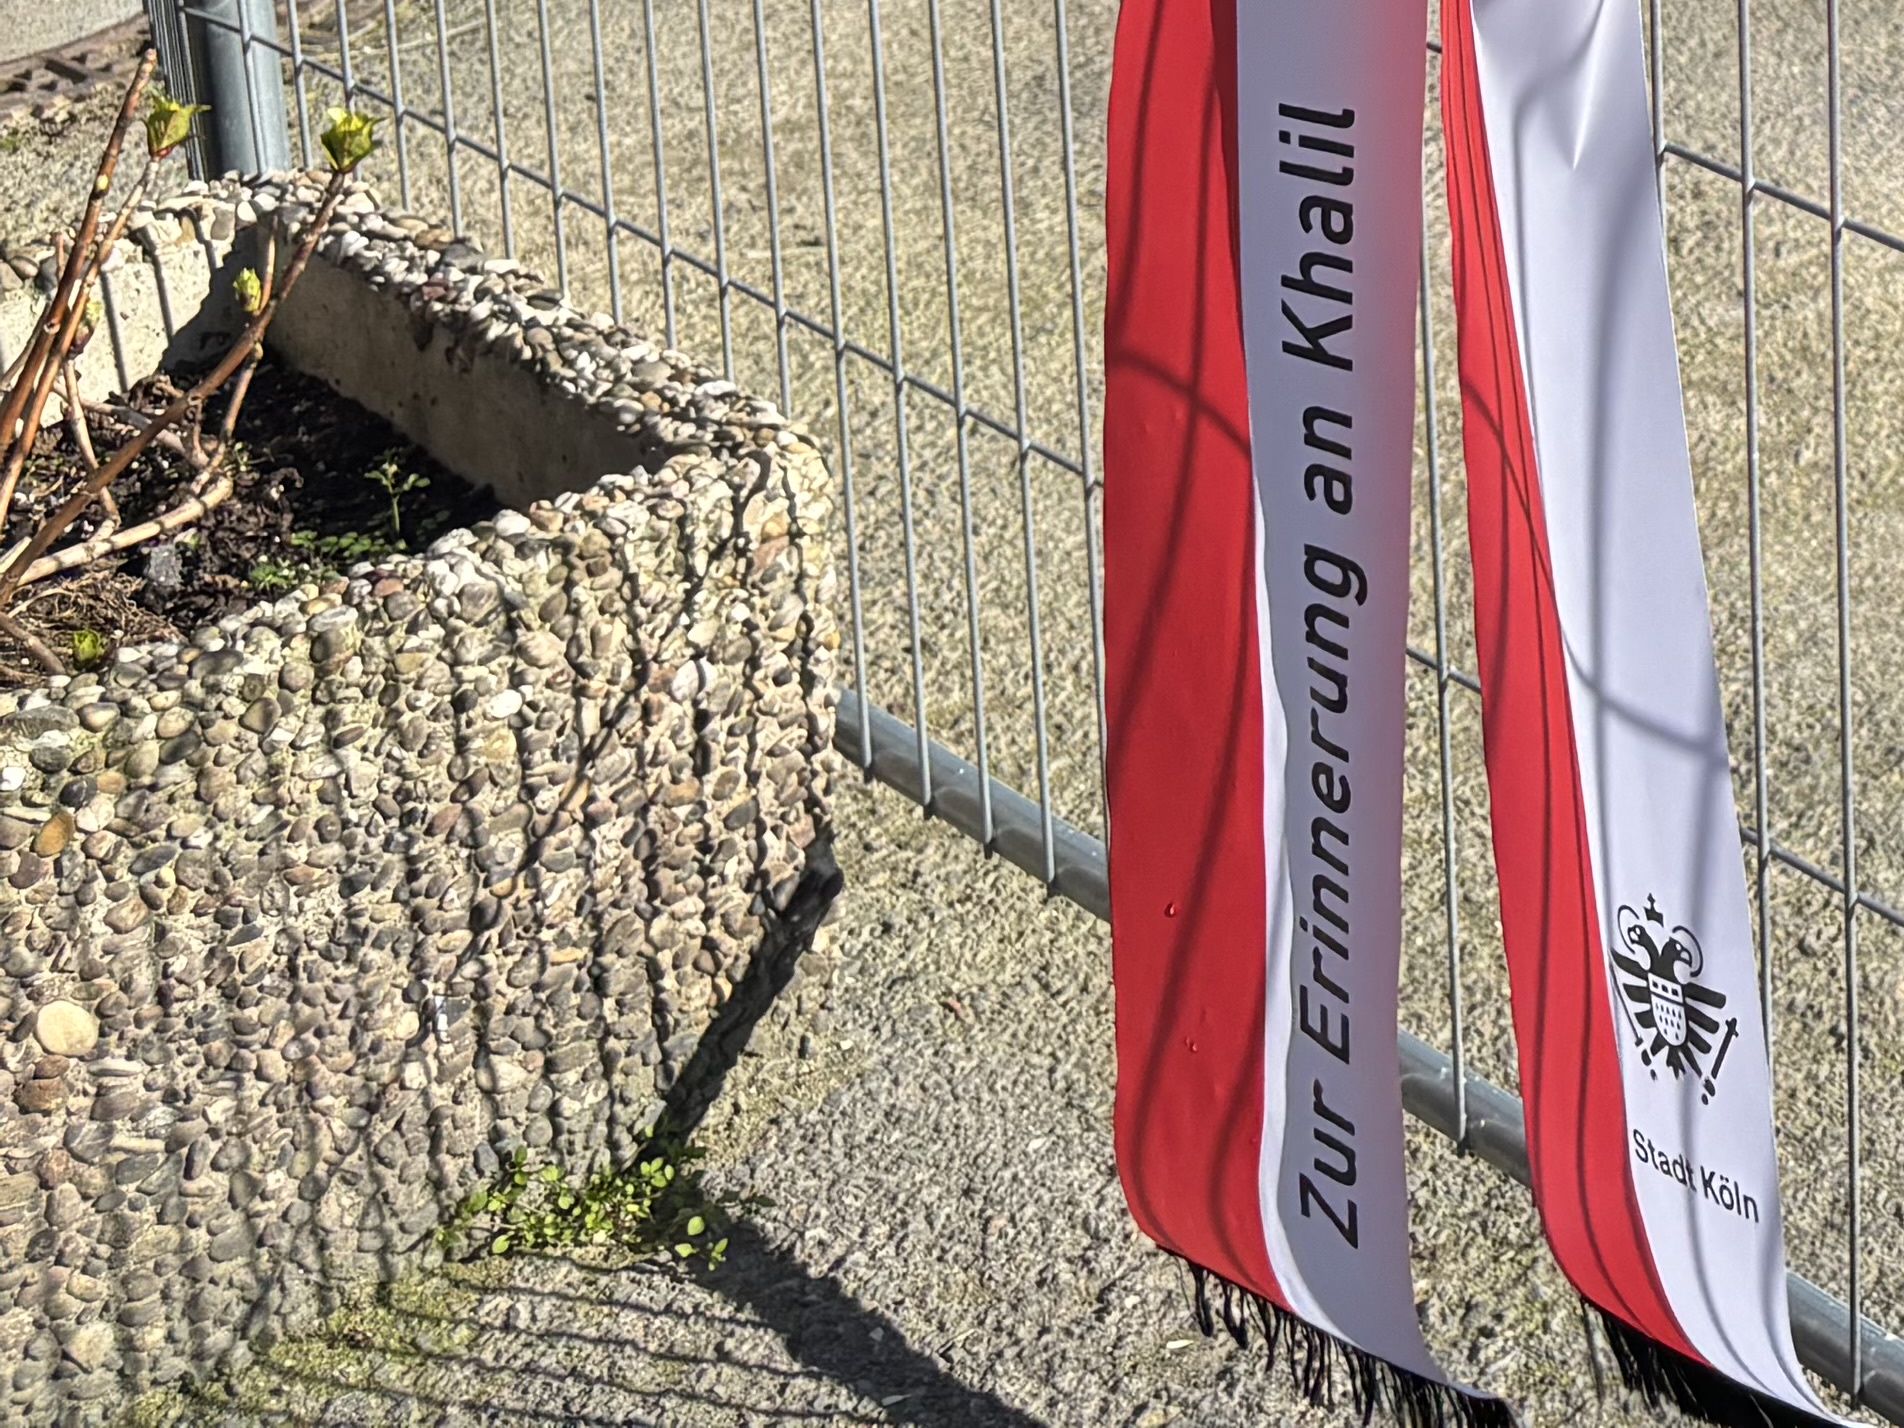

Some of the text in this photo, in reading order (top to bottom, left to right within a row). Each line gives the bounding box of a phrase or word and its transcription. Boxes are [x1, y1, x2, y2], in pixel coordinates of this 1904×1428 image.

[1278, 102, 1368, 1249] Zur Erinnerung an Khalil
[1633, 1129, 1759, 1223] Stadt Köln
